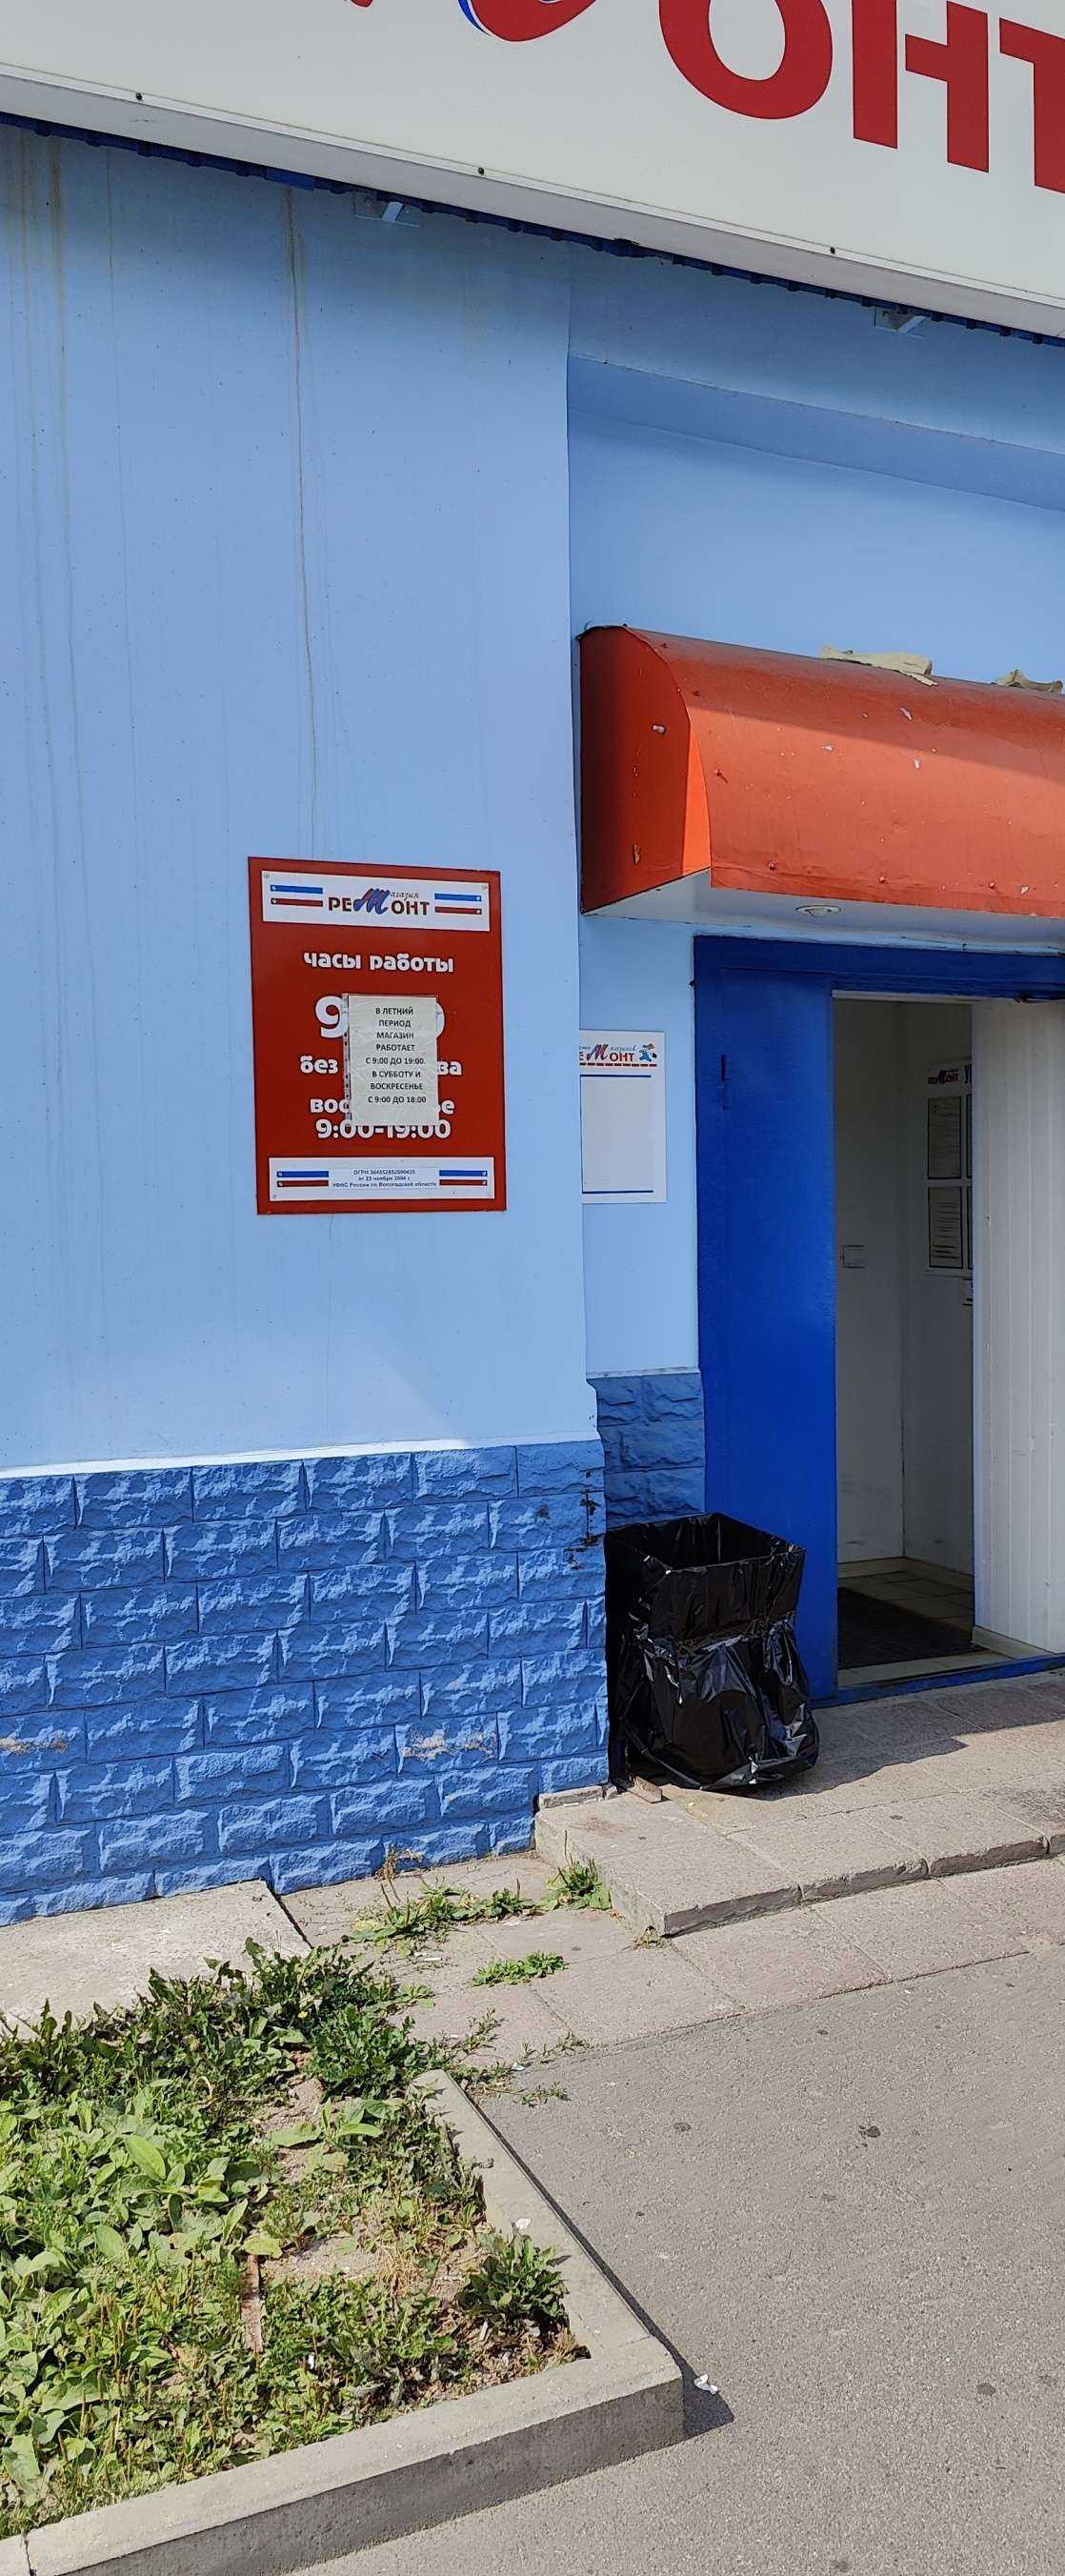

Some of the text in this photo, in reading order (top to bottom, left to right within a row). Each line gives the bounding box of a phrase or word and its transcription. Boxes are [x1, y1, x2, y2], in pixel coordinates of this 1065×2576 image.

[347, 0, 1065, 193] ОНТ
[328, 887, 430, 916] РЕМОНТ
[303, 952, 454, 973] часы работы
[382, 1006, 413, 1015] ЛЕТНИЙ
[378, 1019, 412, 1028] ПЕРИОД
[299, 1055, 339, 1074] без
[391, 1057, 402, 1066] ДО
